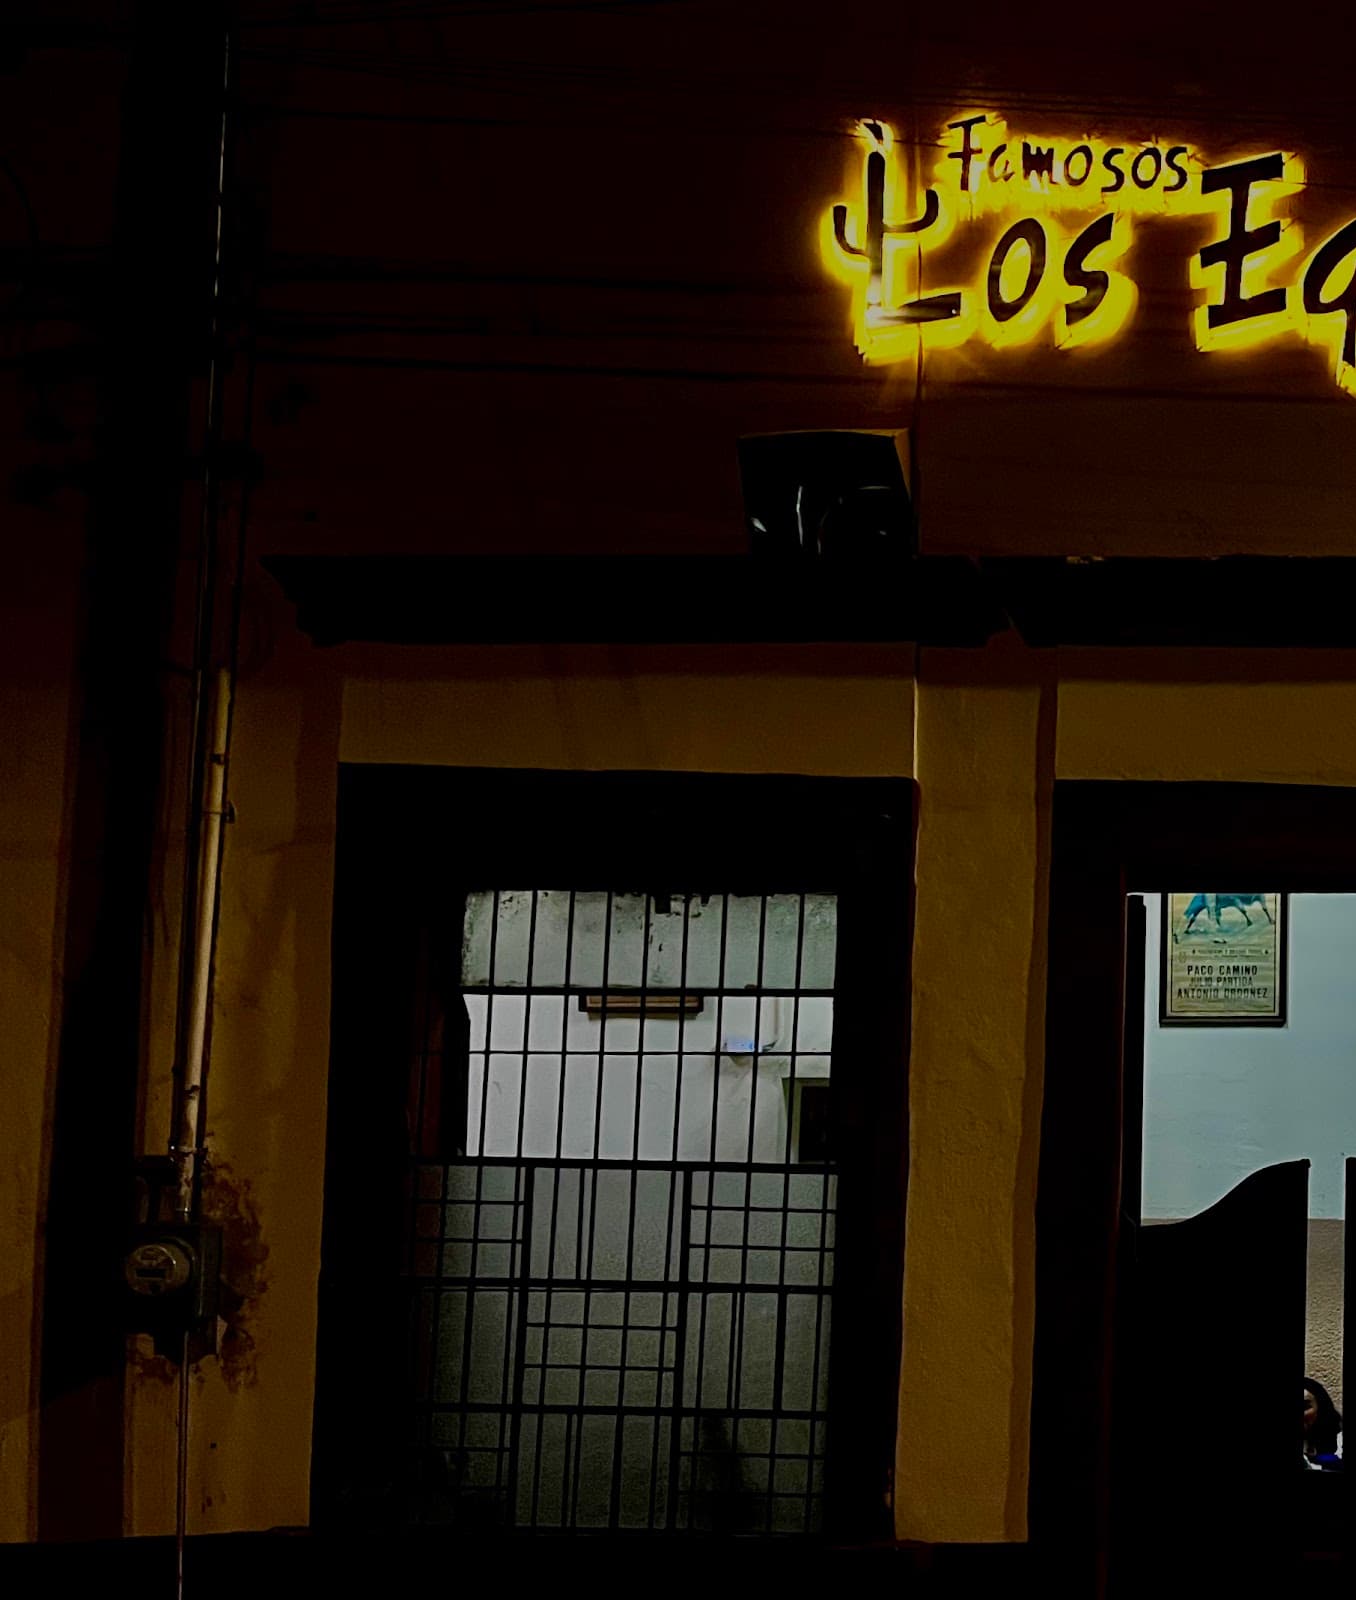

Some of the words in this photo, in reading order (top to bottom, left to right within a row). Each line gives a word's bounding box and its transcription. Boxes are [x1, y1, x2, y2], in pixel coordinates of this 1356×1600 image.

[946, 112, 1189, 194] Famosos
[832, 118, 1116, 328] Los
[1177, 987, 1219, 999] ANTONIO
[1187, 965, 1214, 976] PACO
[1219, 965, 1258, 976] CAMINO
